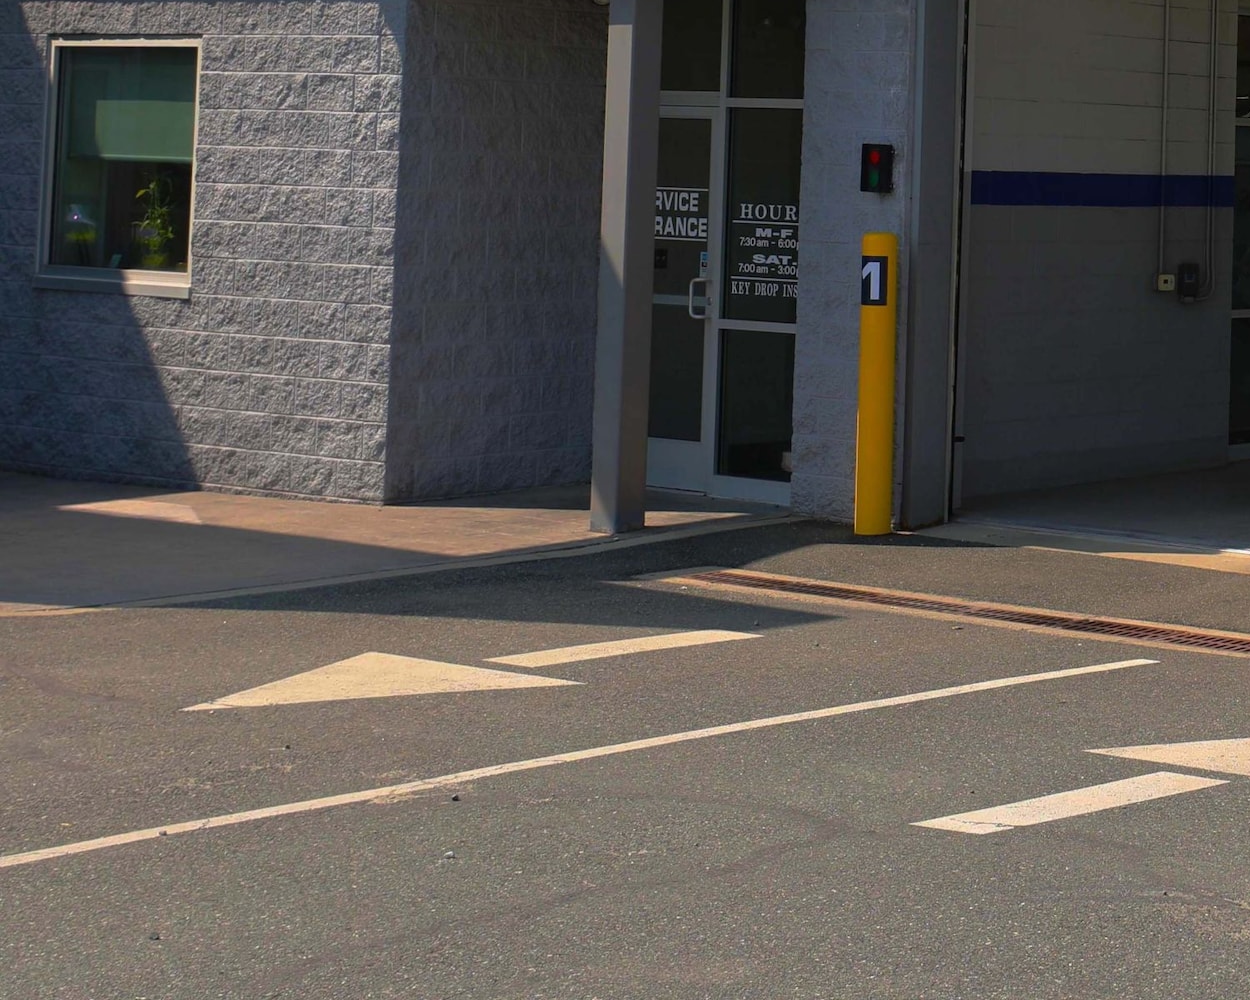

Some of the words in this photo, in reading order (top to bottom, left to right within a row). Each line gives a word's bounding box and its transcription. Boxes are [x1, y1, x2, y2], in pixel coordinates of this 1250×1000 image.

[740, 203, 798, 220] HOUR
[755, 228, 793, 239] M-F
[752, 254, 798, 266] SAT.
[731, 281, 751, 295] KEY
[755, 282, 779, 297] DROP
[862, 262, 880, 300] 1
